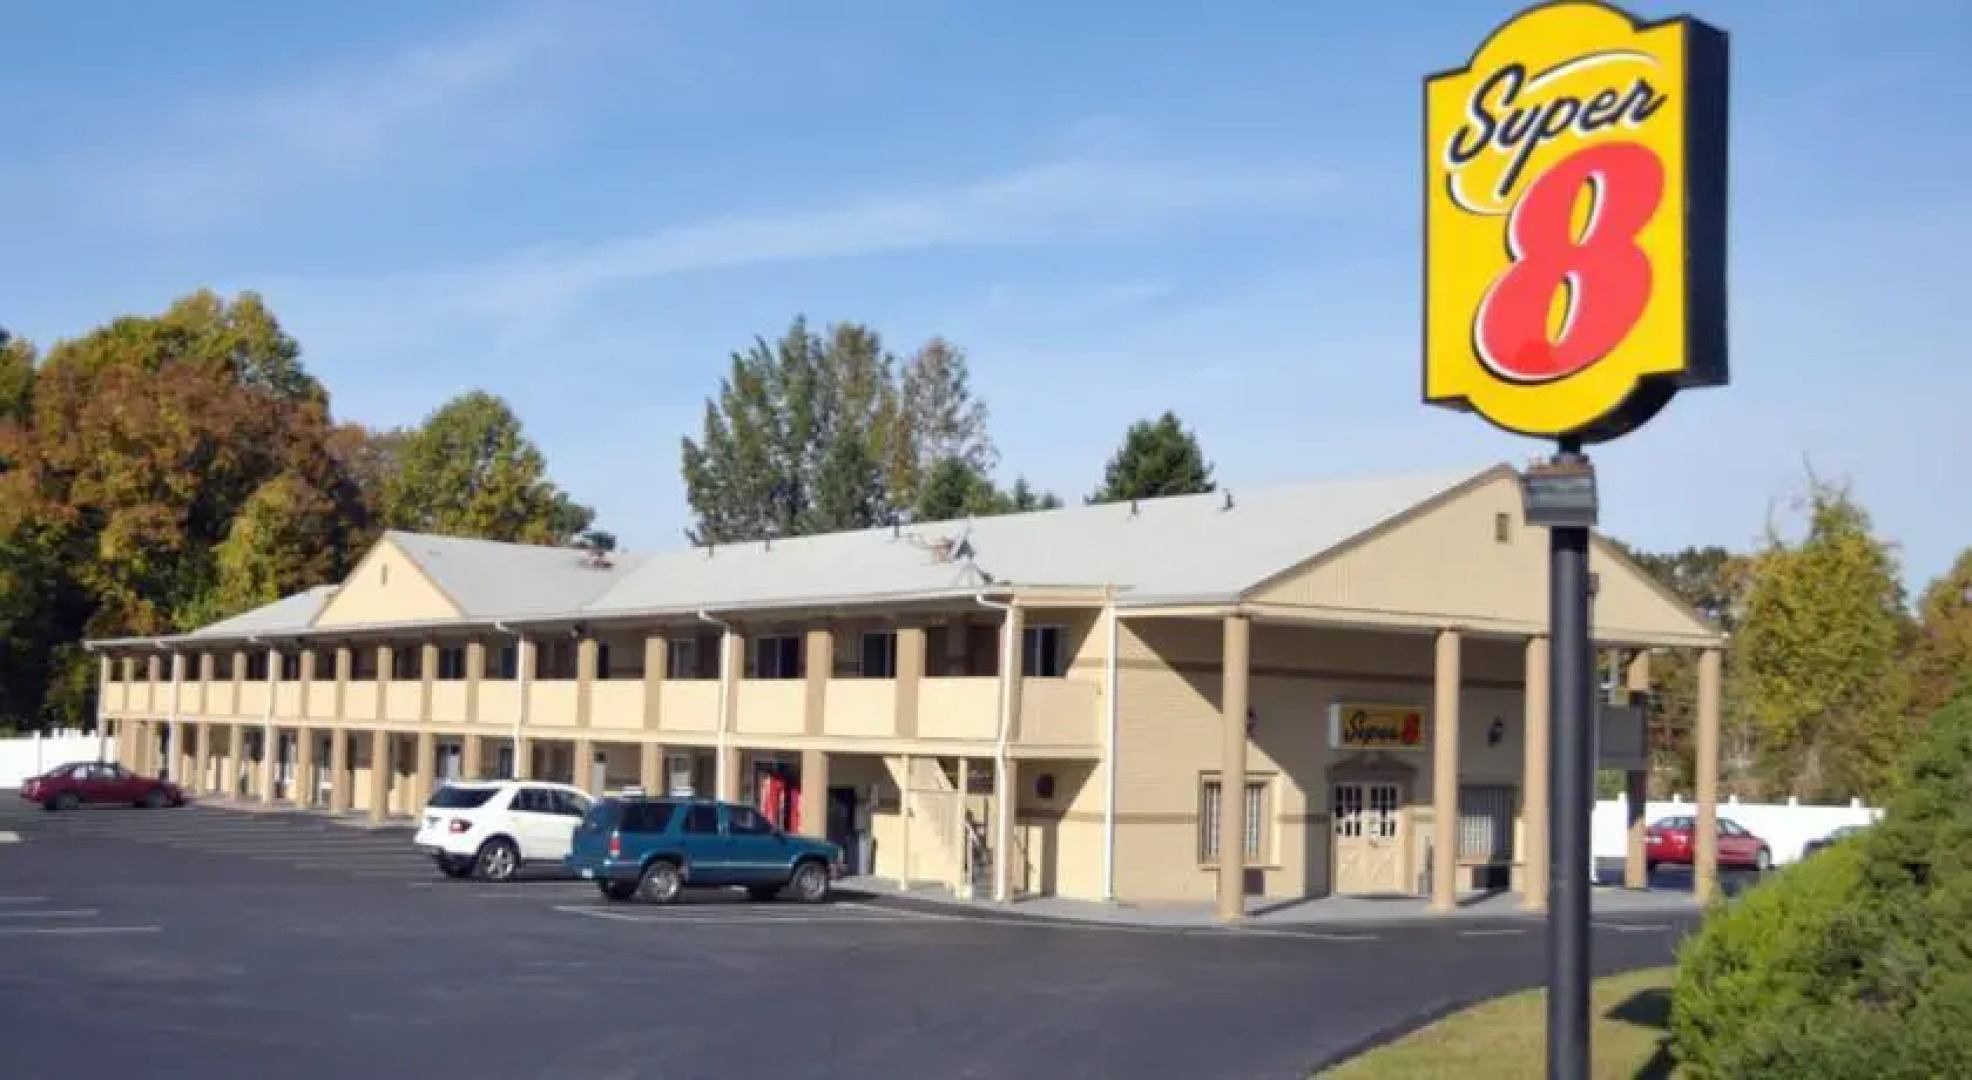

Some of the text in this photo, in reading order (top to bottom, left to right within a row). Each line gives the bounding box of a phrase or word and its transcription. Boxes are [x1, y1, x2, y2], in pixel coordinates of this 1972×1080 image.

[1446, 63, 1669, 199] Super
[1471, 141, 1666, 386] 8
[1344, 710, 1421, 745] Super 8
